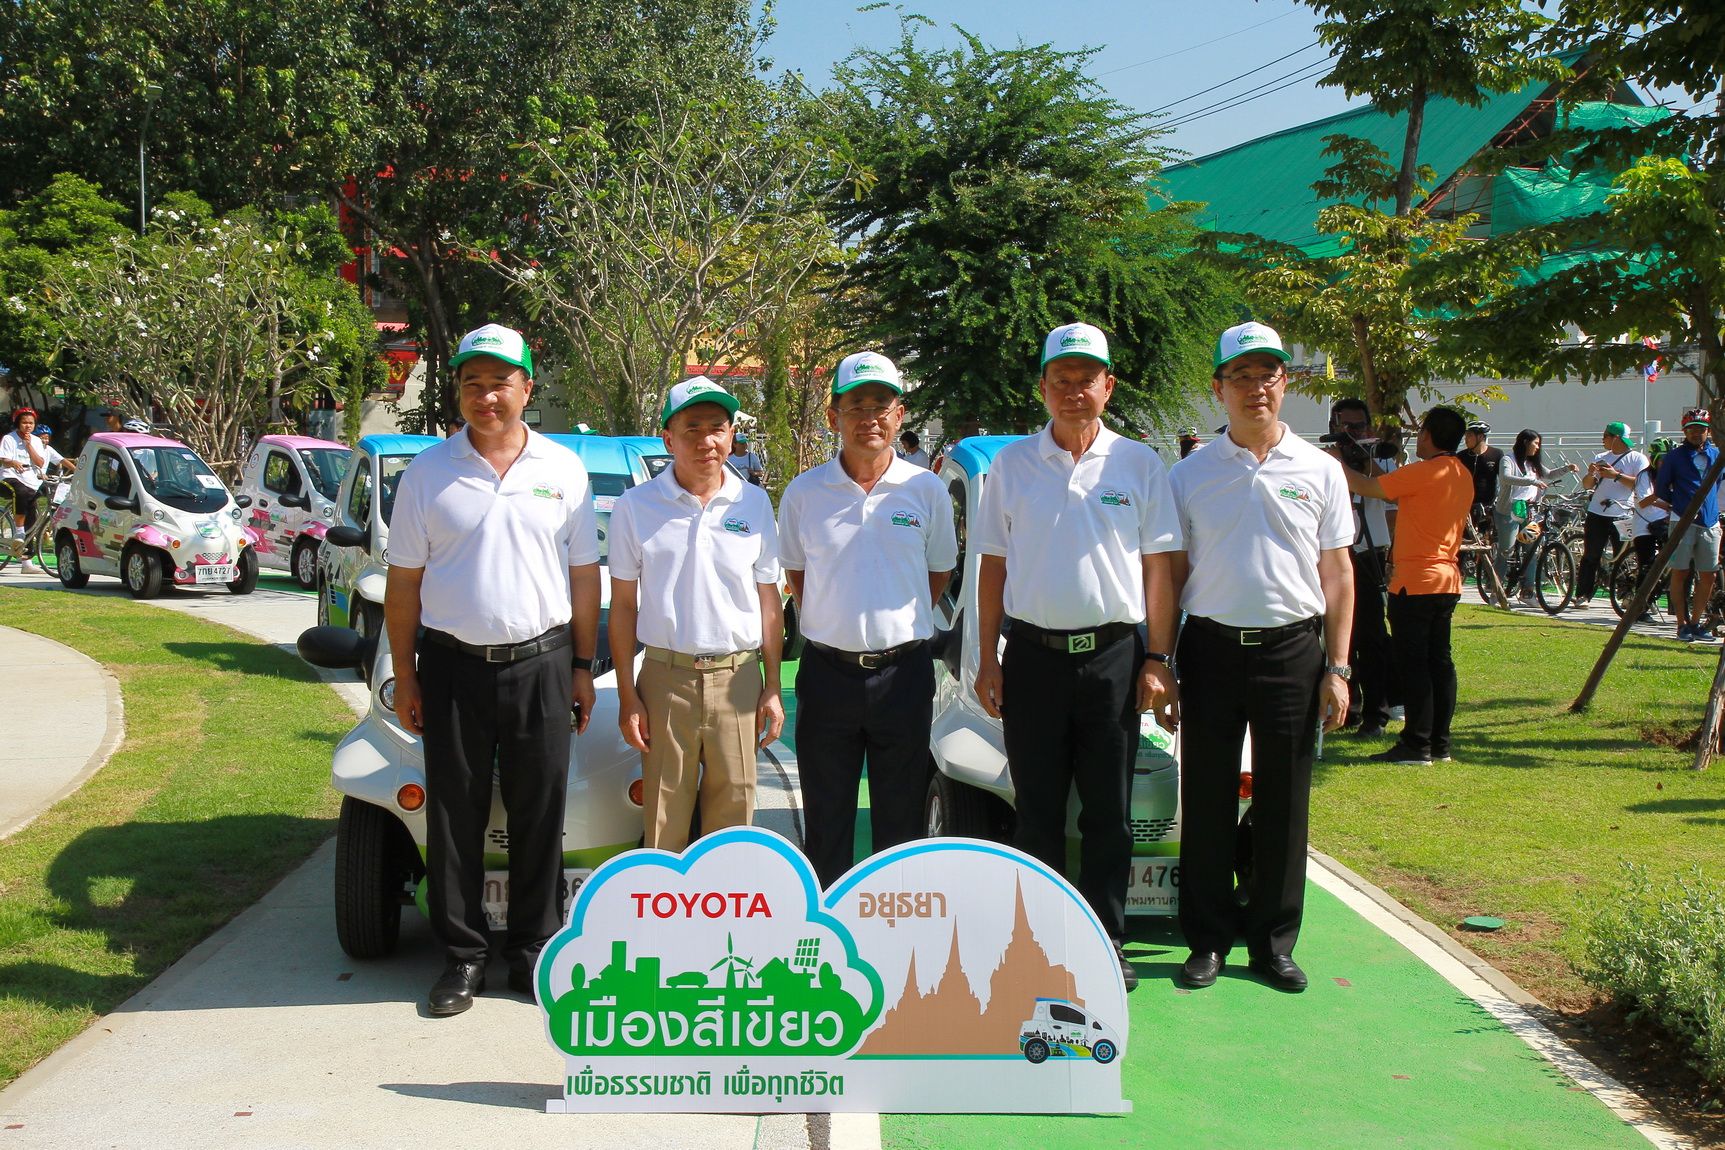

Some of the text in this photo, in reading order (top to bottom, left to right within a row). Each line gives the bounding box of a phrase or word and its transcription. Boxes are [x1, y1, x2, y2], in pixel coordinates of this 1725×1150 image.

[206, 477, 215, 485] 5
[213, 567, 231, 575] 4727
[631, 892, 773, 919] TOYOTA
[859, 892, 947, 928] อยุธยา
[570, 995, 844, 1048] เมืองสีเขียว
[567, 1064, 844, 1103] เพื่อธรรมชาติ เพื่อทุกชีวิต
